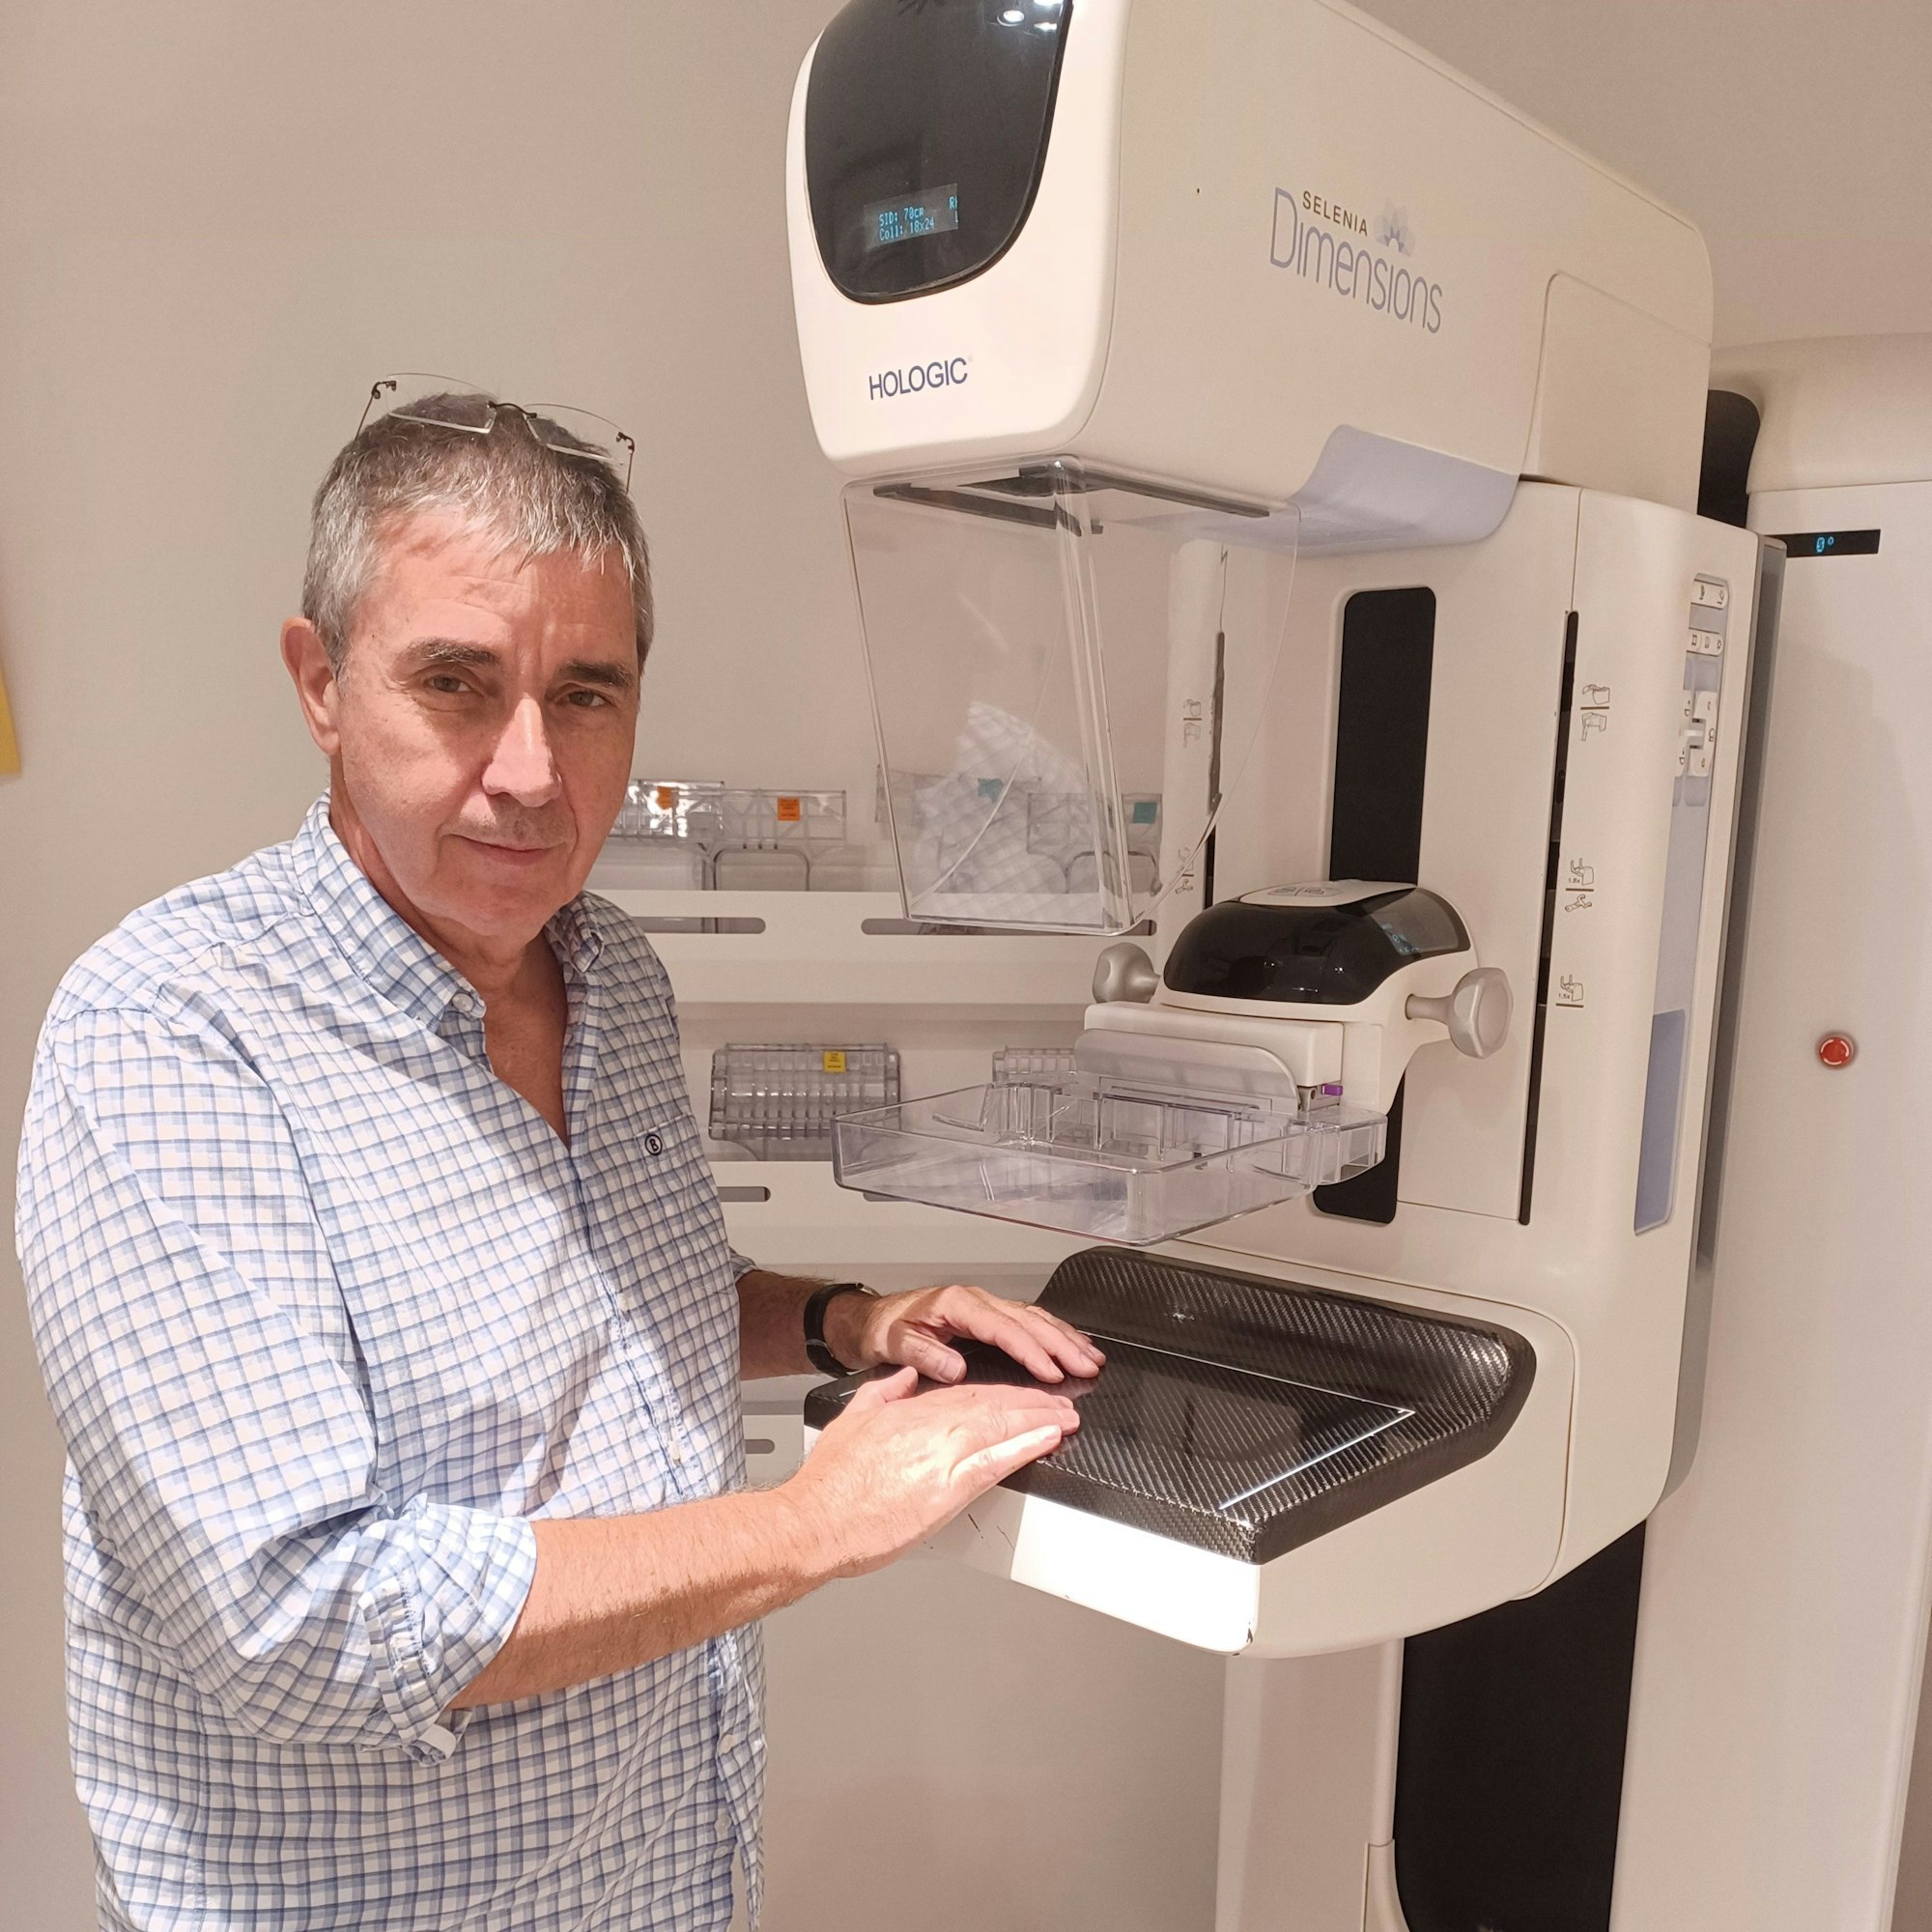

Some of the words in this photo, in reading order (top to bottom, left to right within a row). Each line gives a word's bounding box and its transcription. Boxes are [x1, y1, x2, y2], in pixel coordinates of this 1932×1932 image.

[879, 212, 897, 227] SID:
[903, 207, 924, 220] 70cm
[910, 216, 935, 234] 18x24
[1302, 190, 1368, 238] SELENIA
[1270, 186, 1442, 334] Dimensions
[868, 356, 969, 401] HOLOGIC
